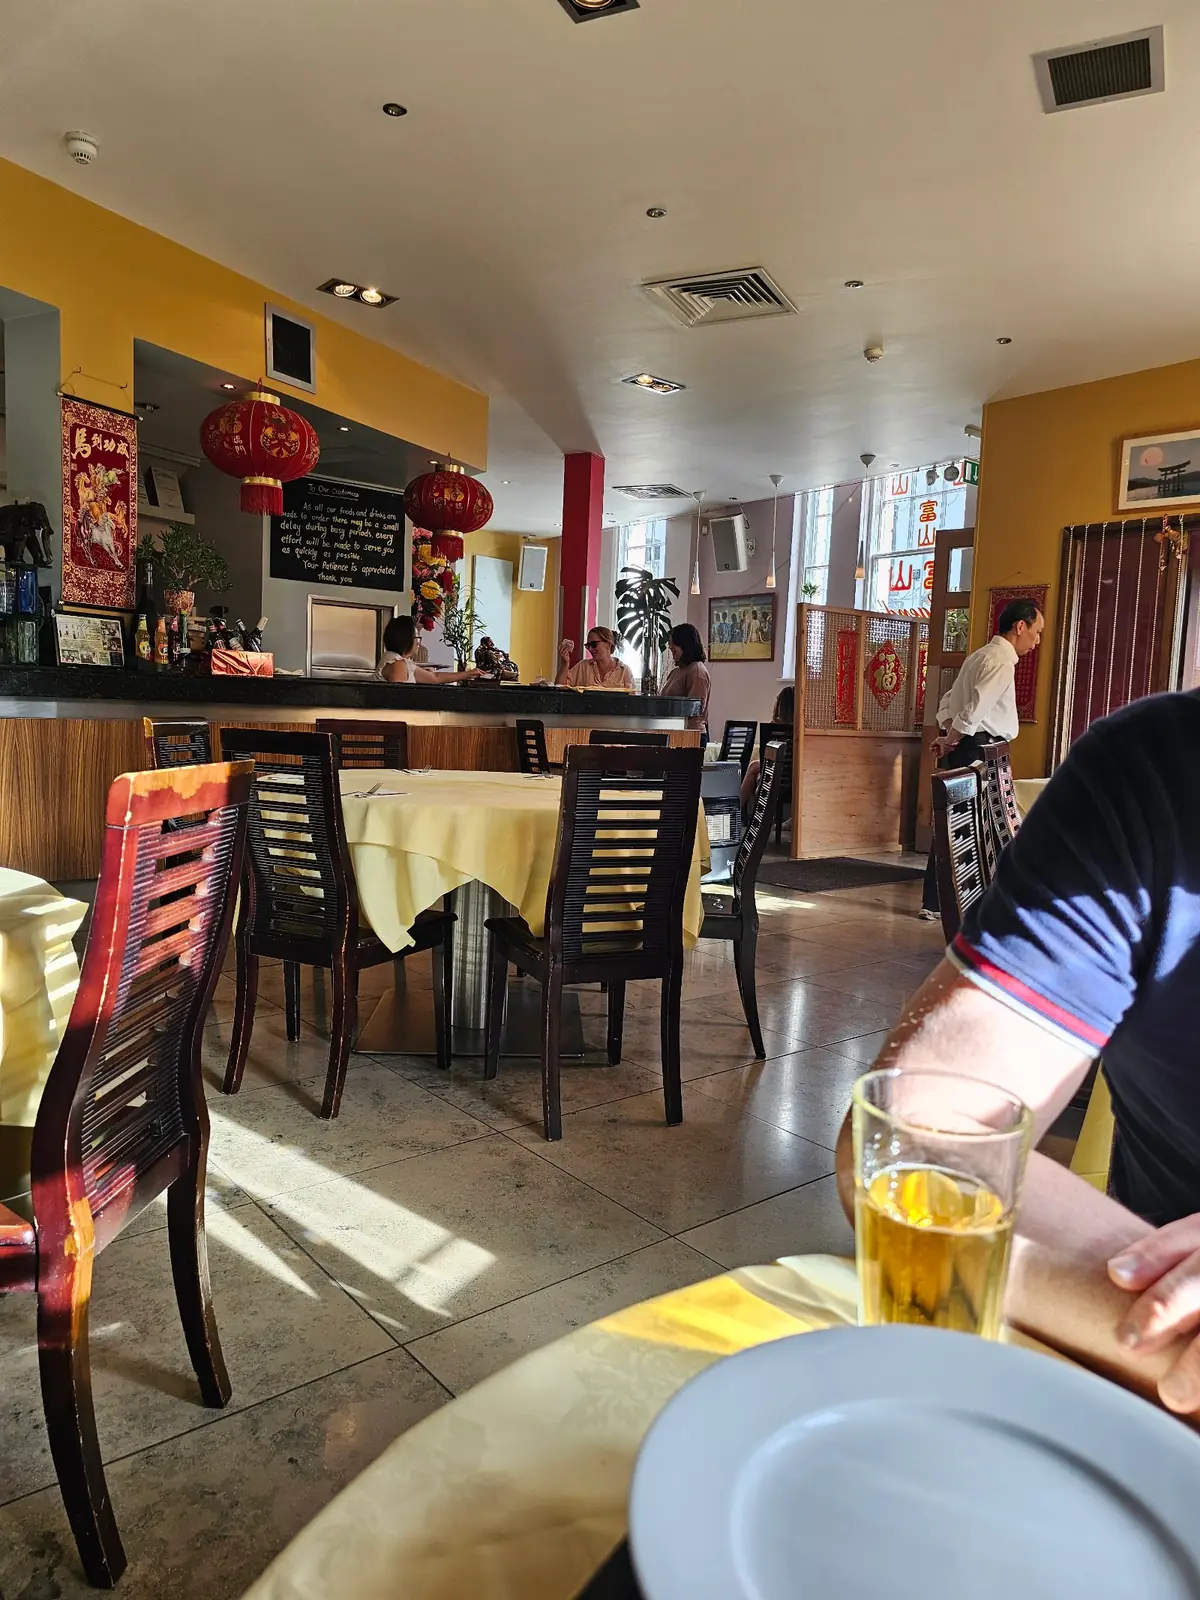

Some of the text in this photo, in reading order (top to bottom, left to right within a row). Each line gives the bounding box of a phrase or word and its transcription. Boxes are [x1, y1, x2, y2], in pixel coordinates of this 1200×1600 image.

[71, 427, 130, 460] 馬到功成
[308, 483, 315, 493] To
[318, 485, 330, 493] Our
[303, 502, 312, 511] As
[340, 507, 355, 517] foods
[356, 509, 367, 517] and
[369, 508, 386, 519] drinks
[300, 511, 307, 520] to
[311, 514, 330, 522] order
[332, 515, 348, 525] there
[350, 520, 363, 531] may
[364, 518, 373, 527] be
[382, 523, 400, 531] small
[280, 520, 301, 537] delay
[305, 522, 328, 539] during
[330, 524, 346, 540] busy
[375, 532, 394, 546] every
[281, 534, 395, 556] effort will be made to serve you
[294, 546, 318, 560] quickly
[302, 559, 397, 577] Your Patience is appreciated
[317, 571, 353, 584] Thank you
